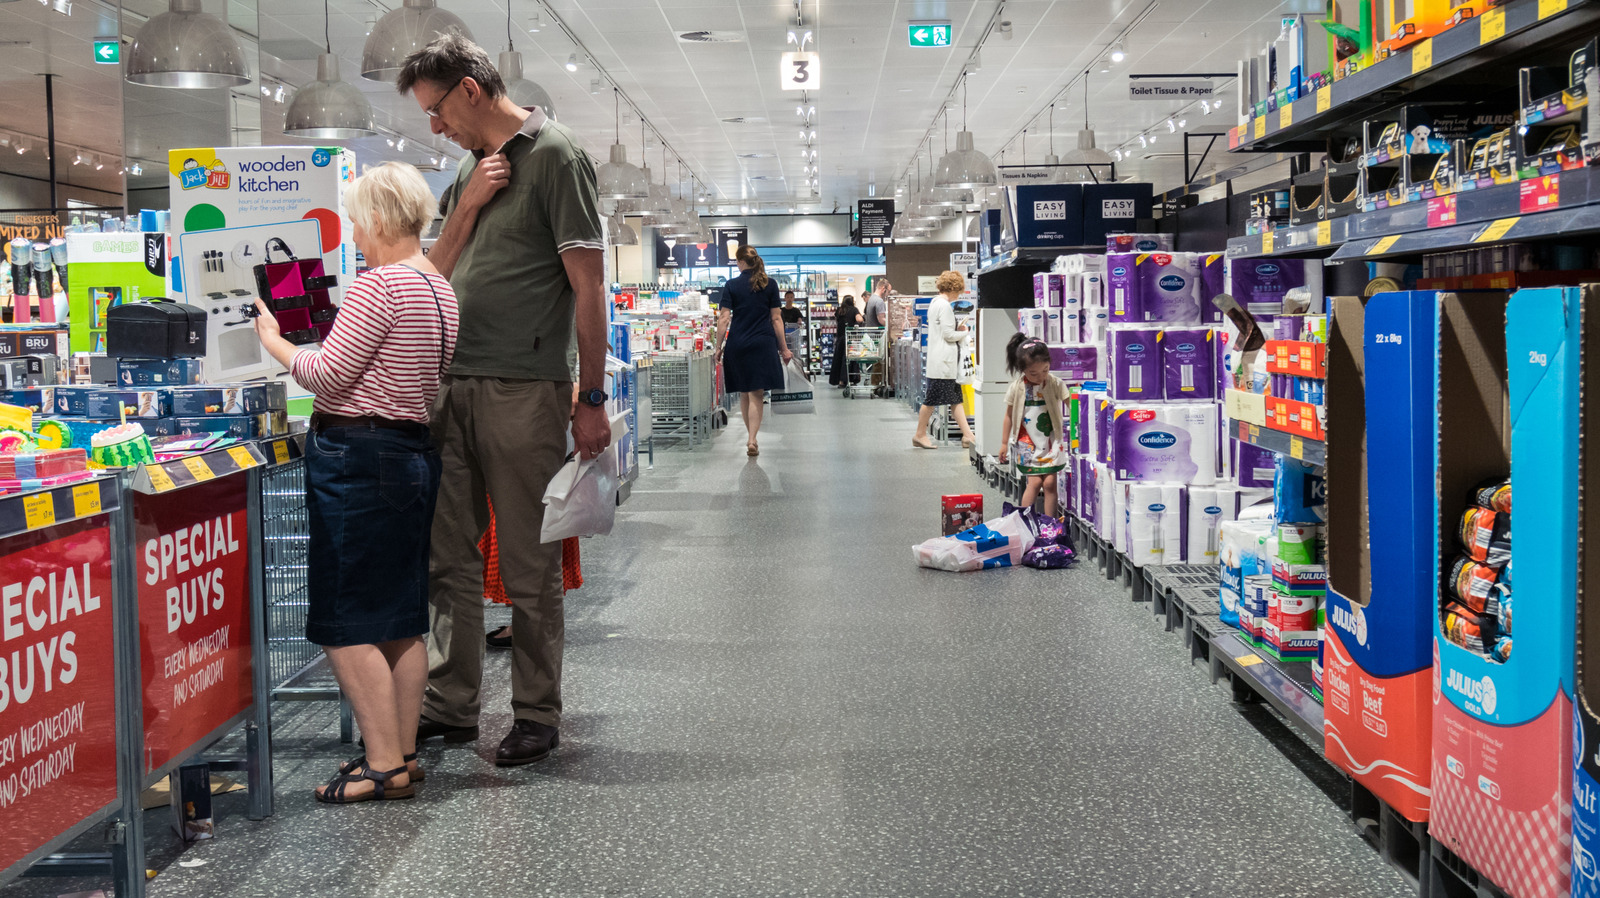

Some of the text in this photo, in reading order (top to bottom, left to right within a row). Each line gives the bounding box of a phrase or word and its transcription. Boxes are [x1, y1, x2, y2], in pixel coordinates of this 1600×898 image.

[792, 61, 809, 83] 3
[1130, 87, 1152, 95] Toilet
[1180, 86, 1187, 94] &
[1189, 86, 1212, 95] Paper
[1473, 114, 1514, 124] JULIUS
[239, 154, 328, 172] wooden 3+
[185, 170, 204, 187] jack
[238, 176, 299, 192] kitchen
[0, 226, 40, 240] MIXED
[93, 240, 139, 253] GAMES
[26, 339, 49, 347] BRU
[1376, 334, 1384, 343] 22
[1529, 351, 1546, 366] 2kg
[145, 513, 239, 585] SPECIAL
[1298, 572, 1326, 580] JULIUS
[166, 567, 224, 634] BUYS
[1332, 605, 1357, 635] JULIUS
[164, 625, 230, 679] EVERY WEDNESDAY
[174, 657, 224, 709] AND SATURDAY
[1328, 668, 1350, 697] Chicken
[1374, 684, 1385, 695] Food
[1447, 668, 1482, 703] JULIUS
[1363, 690, 1382, 715] Beef
[1464, 700, 1481, 716] GOLD
[20, 701, 85, 758] WEDNESDAY
[20, 742, 76, 797] SATURDAY
